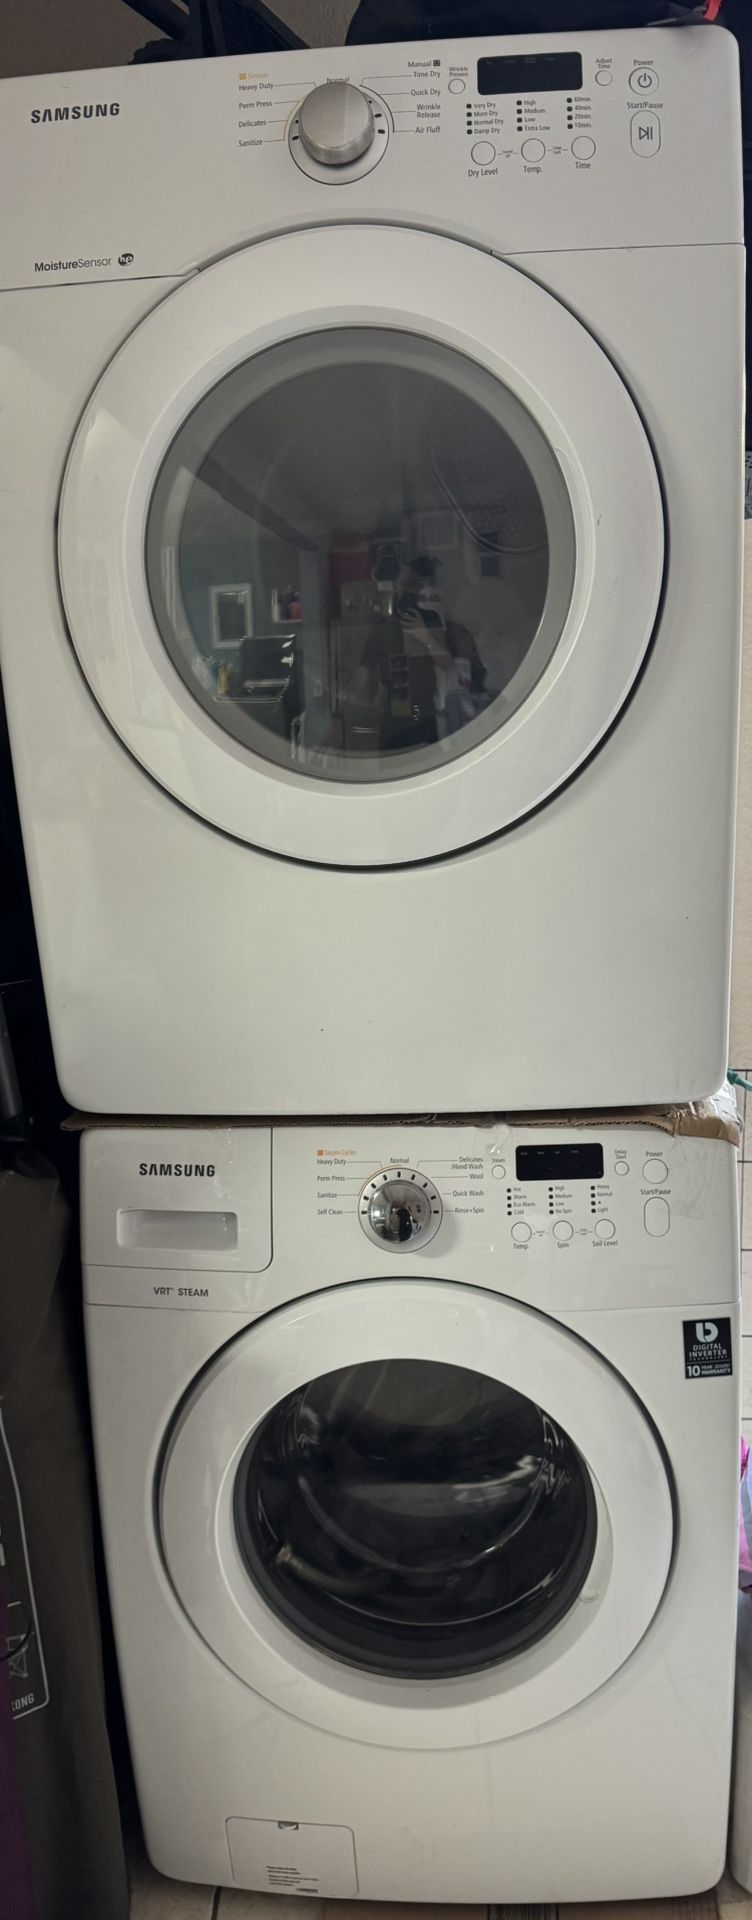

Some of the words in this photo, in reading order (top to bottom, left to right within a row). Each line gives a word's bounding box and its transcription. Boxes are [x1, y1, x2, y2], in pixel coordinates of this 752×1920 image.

[430, 70, 440, 78] Dry
[430, 88, 440, 96] Dry
[626, 102, 664, 110] Start/Pause
[30, 102, 120, 124] SAMSUNG
[239, 120, 266, 128] Delicates
[426, 125, 440, 134] Fluff
[523, 166, 544, 174] Temp.
[576, 162, 592, 170] Time
[468, 169, 480, 178] Dry
[480, 168, 498, 176] Level
[34, 258, 112, 272] MoistureSensor
[138, 1162, 216, 1178] SAMSUNG
[556, 1242, 570, 1250] Spin
[178, 1288, 209, 1298] STEAM
[692, 1343, 723, 1351] DIGITAL
[688, 1348, 728, 1358] INVERTER
[686, 1364, 700, 1377] 10
[701, 1368, 732, 1376] WARRANTY
